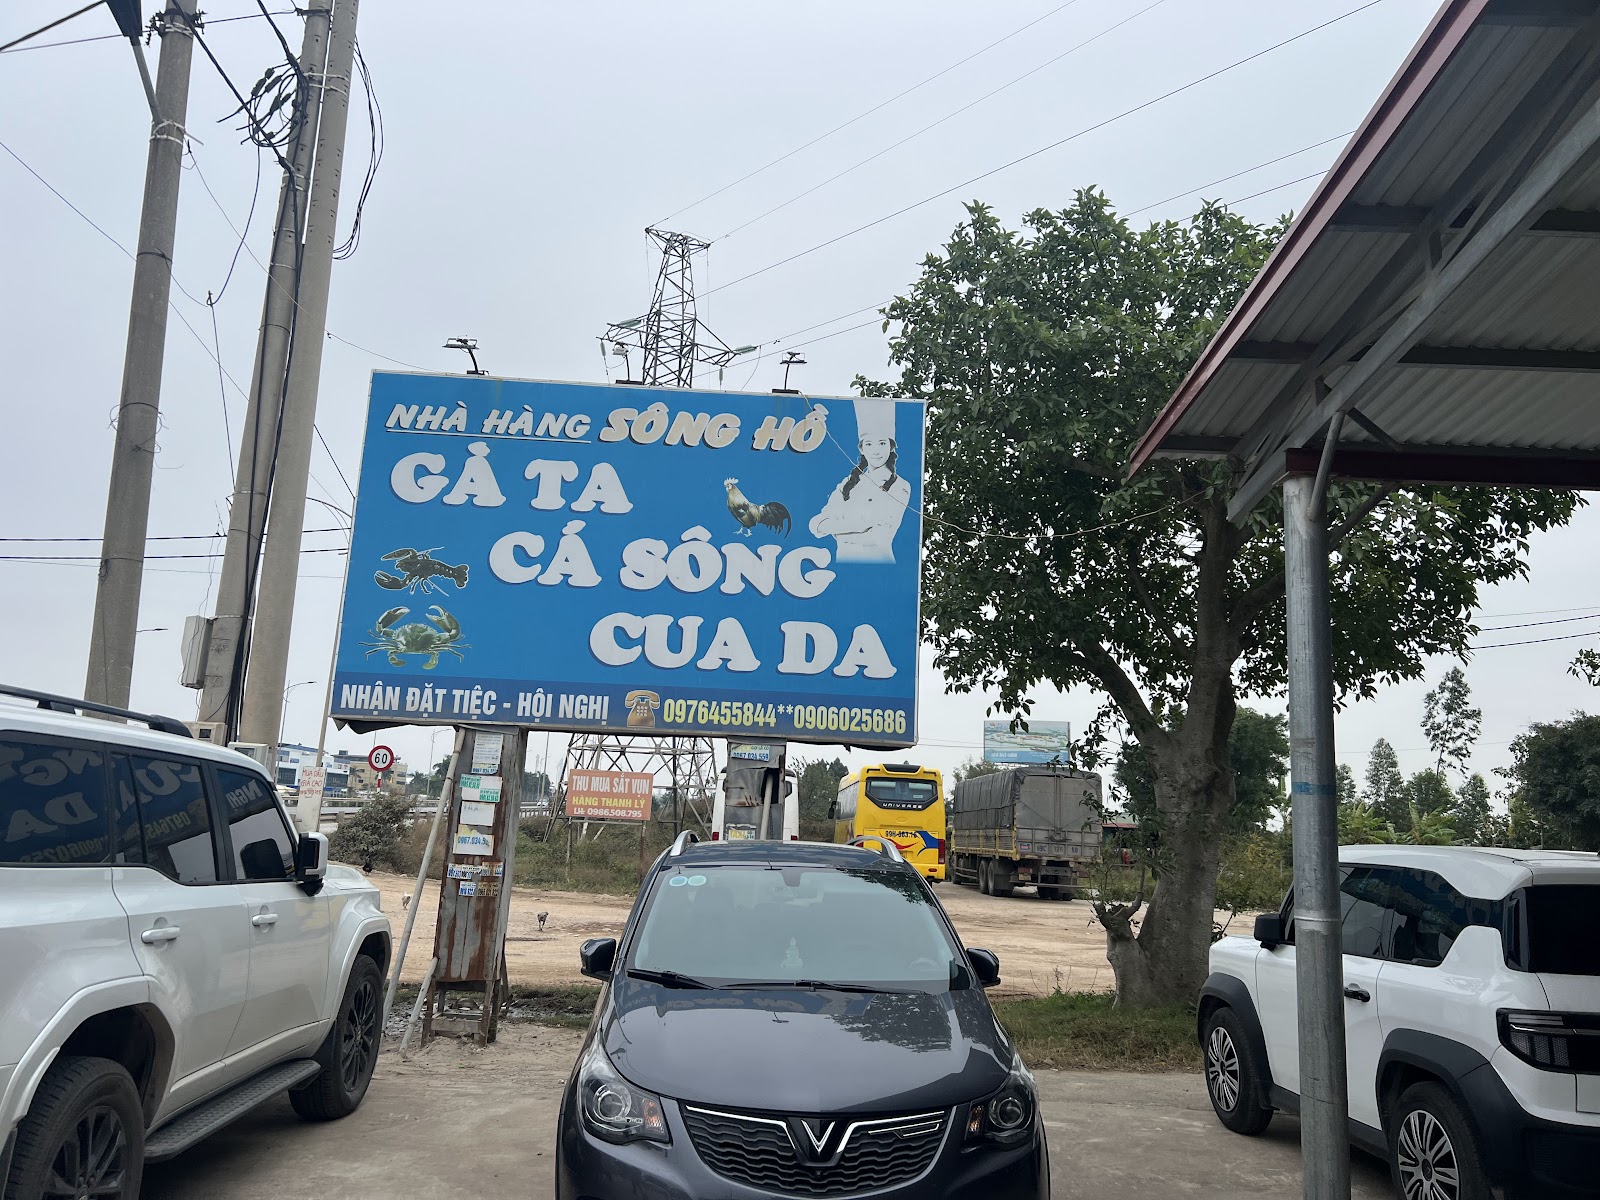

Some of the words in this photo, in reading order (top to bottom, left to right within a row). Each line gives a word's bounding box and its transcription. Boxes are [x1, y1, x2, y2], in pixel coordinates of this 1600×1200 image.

[385, 400, 467, 432] NHÀ
[481, 404, 592, 439] HÀNG
[598, 401, 742, 449] SÔNG
[752, 403, 830, 453] HỒ
[390, 441, 507, 507] GÀ
[524, 458, 634, 514] TA
[489, 519, 603, 588] CÁ
[619, 525, 837, 599] SÔNG
[589, 612, 761, 672] CUA
[777, 620, 898, 679] DA
[340, 680, 401, 716] NHẬN
[406, 682, 447, 718] ĐẶT
[452, 685, 497, 720] TIỆC
[517, 688, 552, 723] HỘI
[558, 694, 610, 726] NGHỊ
[374, 752, 388, 764] 60
[572, 775, 589, 791] THU
[591, 776, 611, 793] MUA
[612, 773, 631, 794] SẮT
[631, 778, 650, 798] VỤN
[572, 795, 599, 806] HÀNG
[601, 797, 632, 808] THANH
[634, 798, 646, 809] LÝ
[587, 808, 643, 818] 0986.508.795
